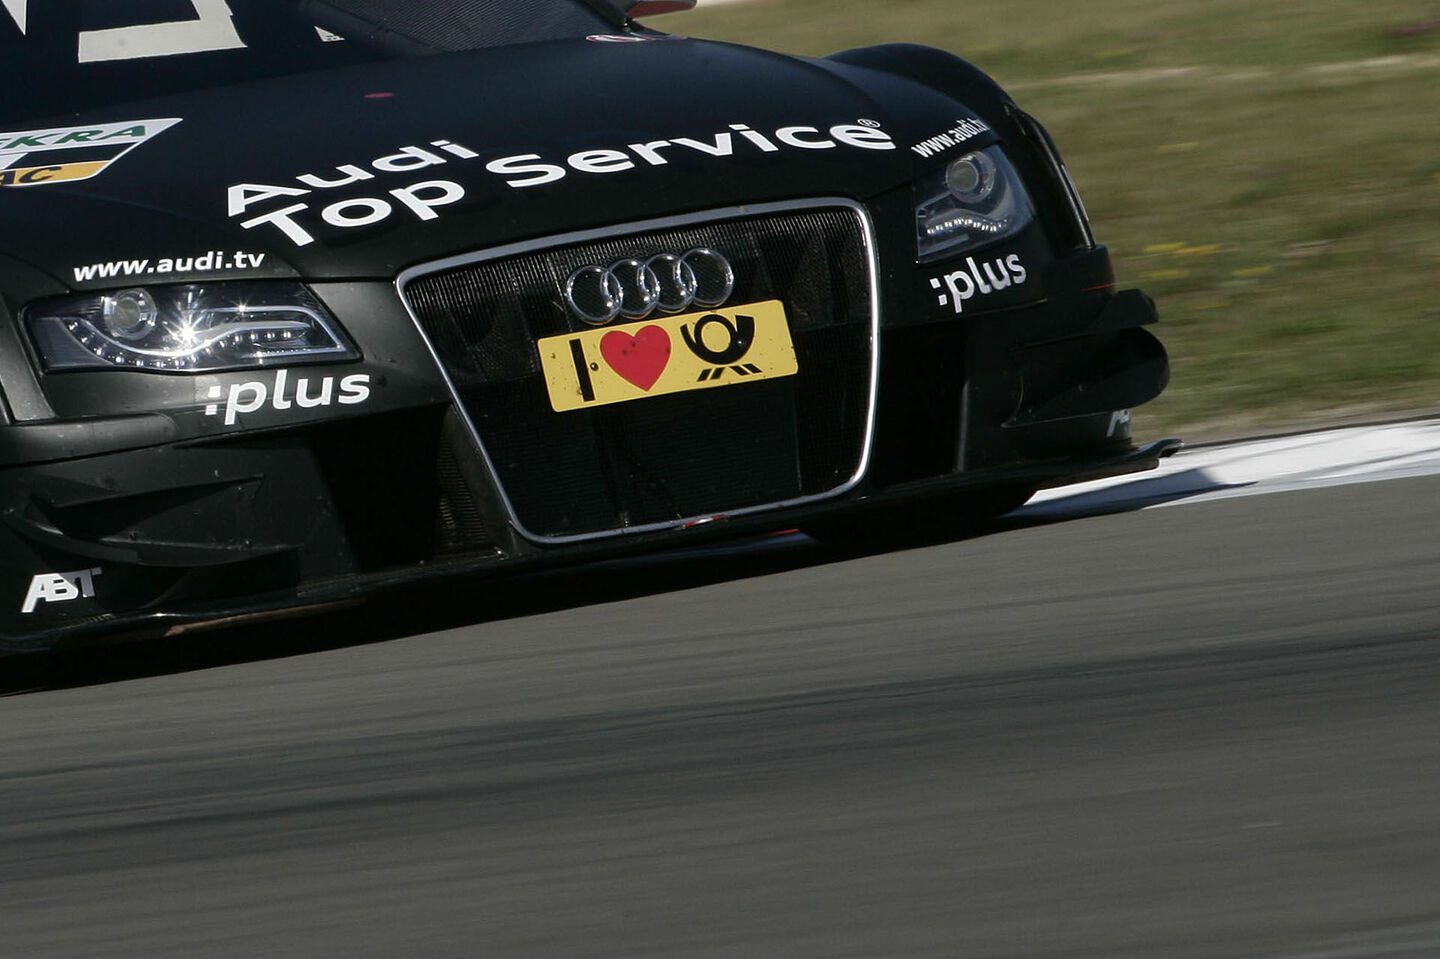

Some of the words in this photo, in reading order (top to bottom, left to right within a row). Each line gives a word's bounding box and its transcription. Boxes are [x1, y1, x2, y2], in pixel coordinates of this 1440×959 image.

[227, 139, 481, 217] Audi
[240, 178, 468, 247] Top
[73, 250, 265, 282] www.audi.tv
[20, 567, 103, 614] ABT
